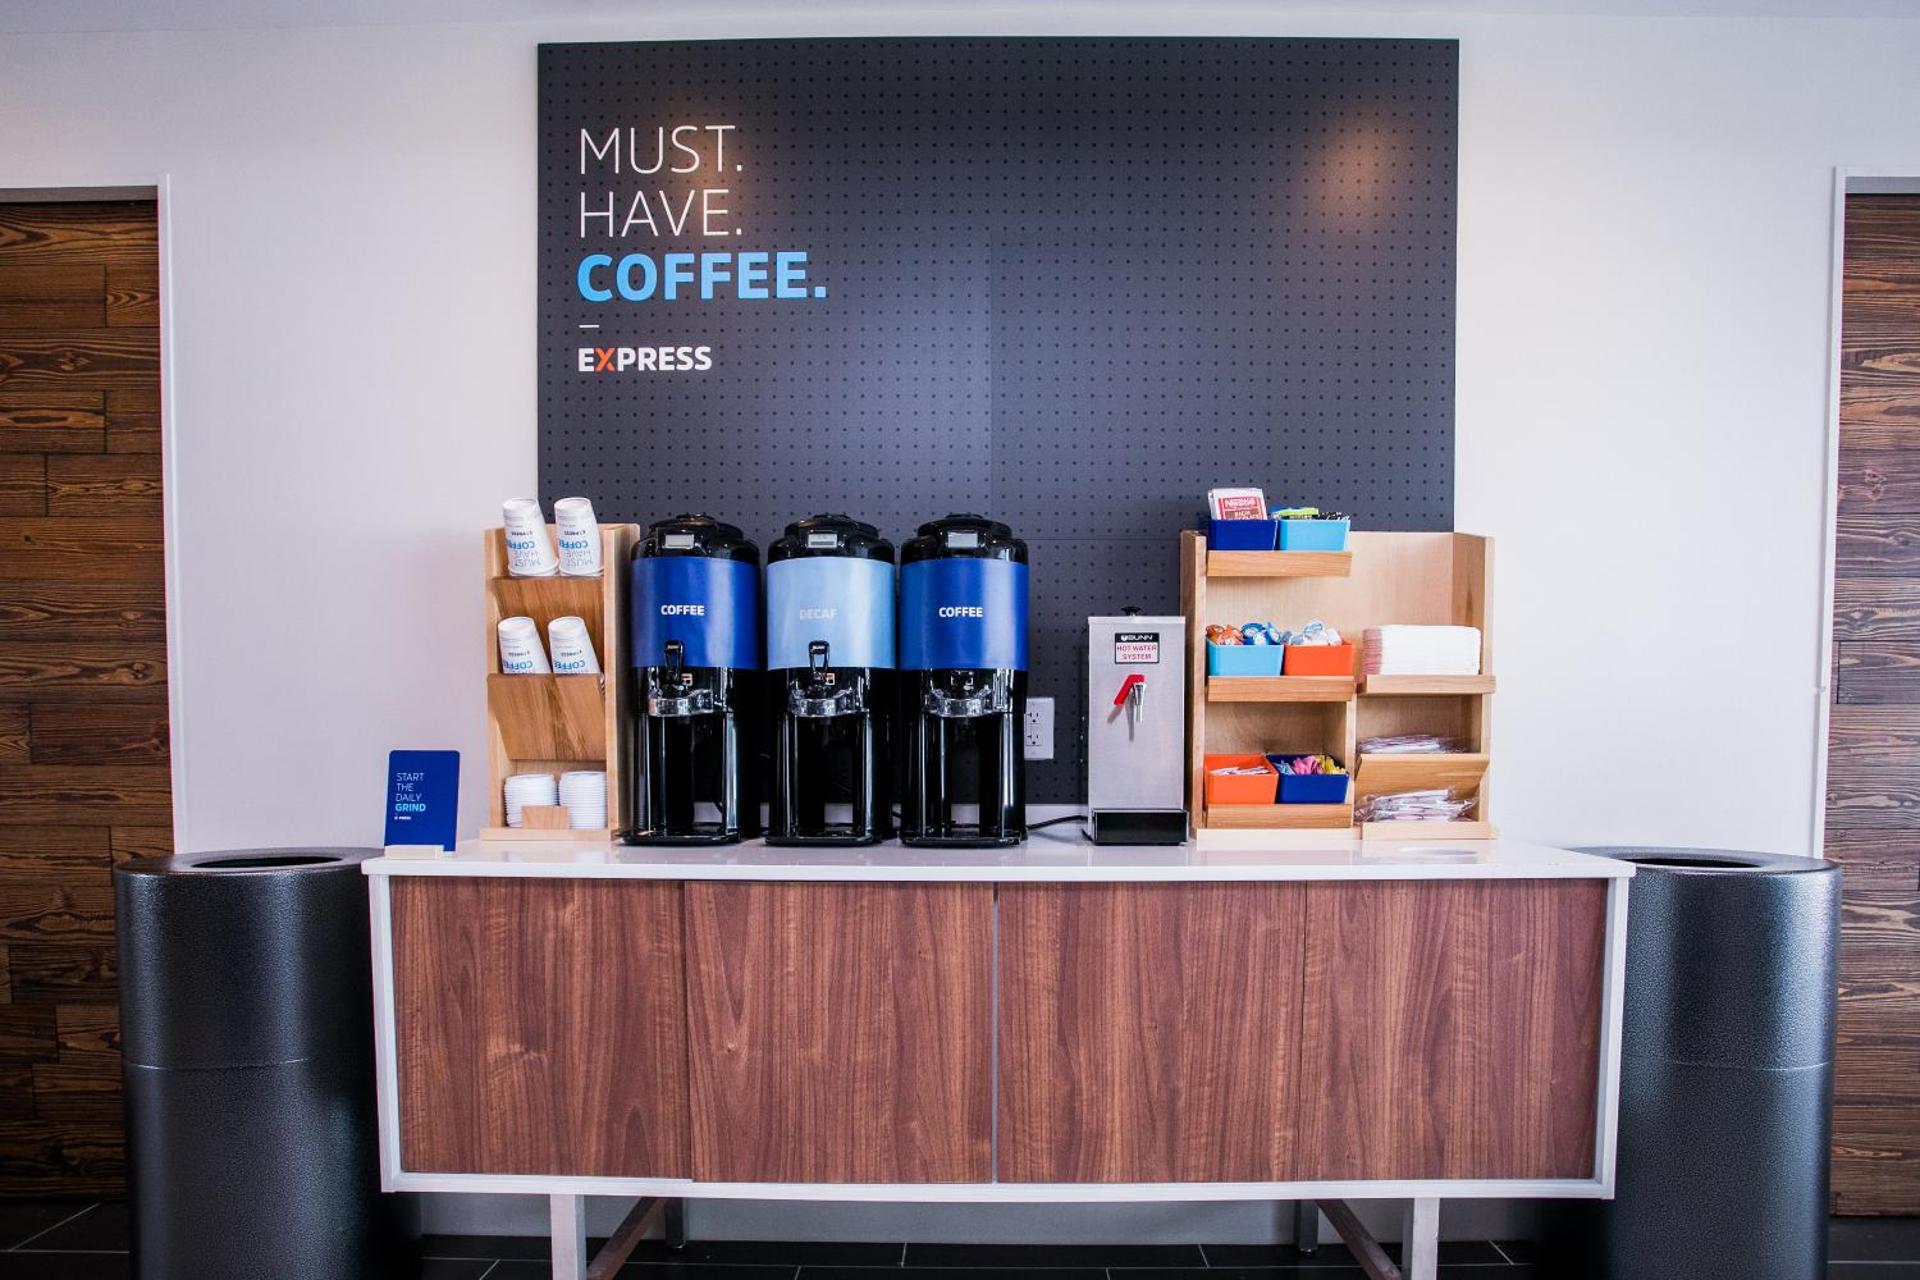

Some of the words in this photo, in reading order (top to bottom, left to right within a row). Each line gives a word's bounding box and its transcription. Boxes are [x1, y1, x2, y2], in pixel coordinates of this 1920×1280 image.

[580, 125, 743, 175] MUST.
[580, 189, 743, 238] HAVE.
[577, 251, 827, 302] COFFEE.
[578, 346, 712, 372] EXPRESS
[661, 604, 705, 616] COFFEE
[800, 608, 838, 620] DECAF
[938, 606, 984, 618] COFFEE
[1132, 644, 1157, 652] WATER
[397, 772, 425, 781] START
[397, 783, 414, 792] THE
[396, 793, 422, 801] DAILY
[395, 803, 426, 812] GRIND
